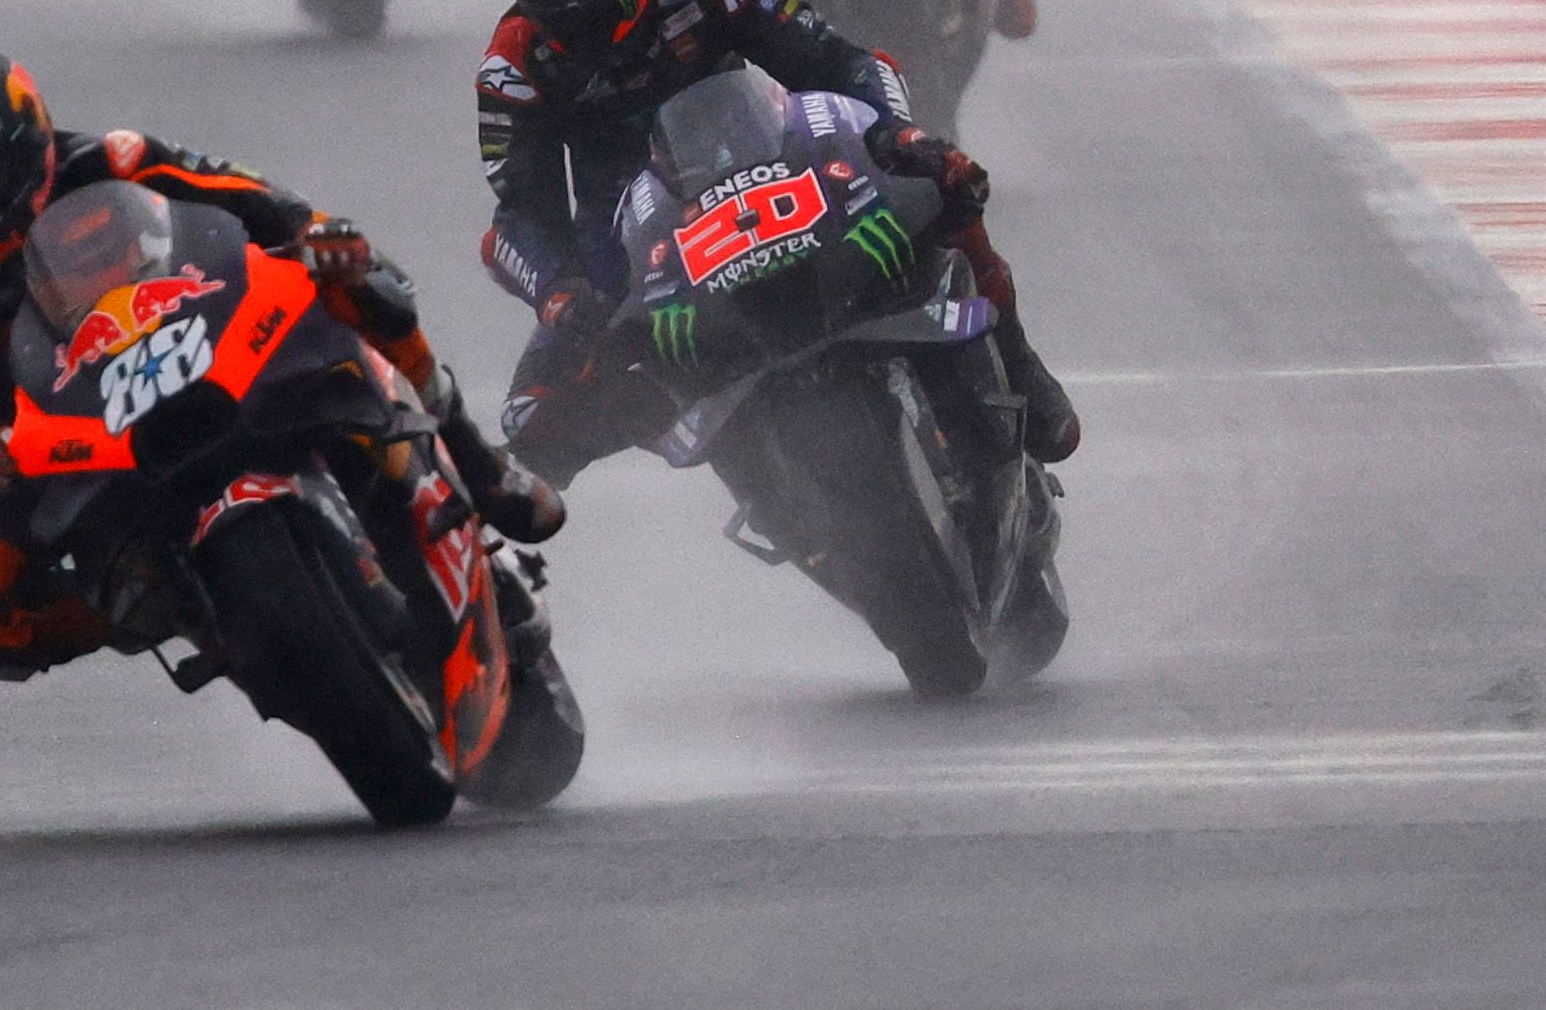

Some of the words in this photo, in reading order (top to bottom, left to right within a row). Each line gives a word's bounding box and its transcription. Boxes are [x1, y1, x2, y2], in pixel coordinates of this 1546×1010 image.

[801, 92, 836, 139] YAMAHA
[699, 161, 791, 212] ENEOS
[493, 233, 538, 298] YAMAHA
[706, 231, 822, 294] MONSTER
